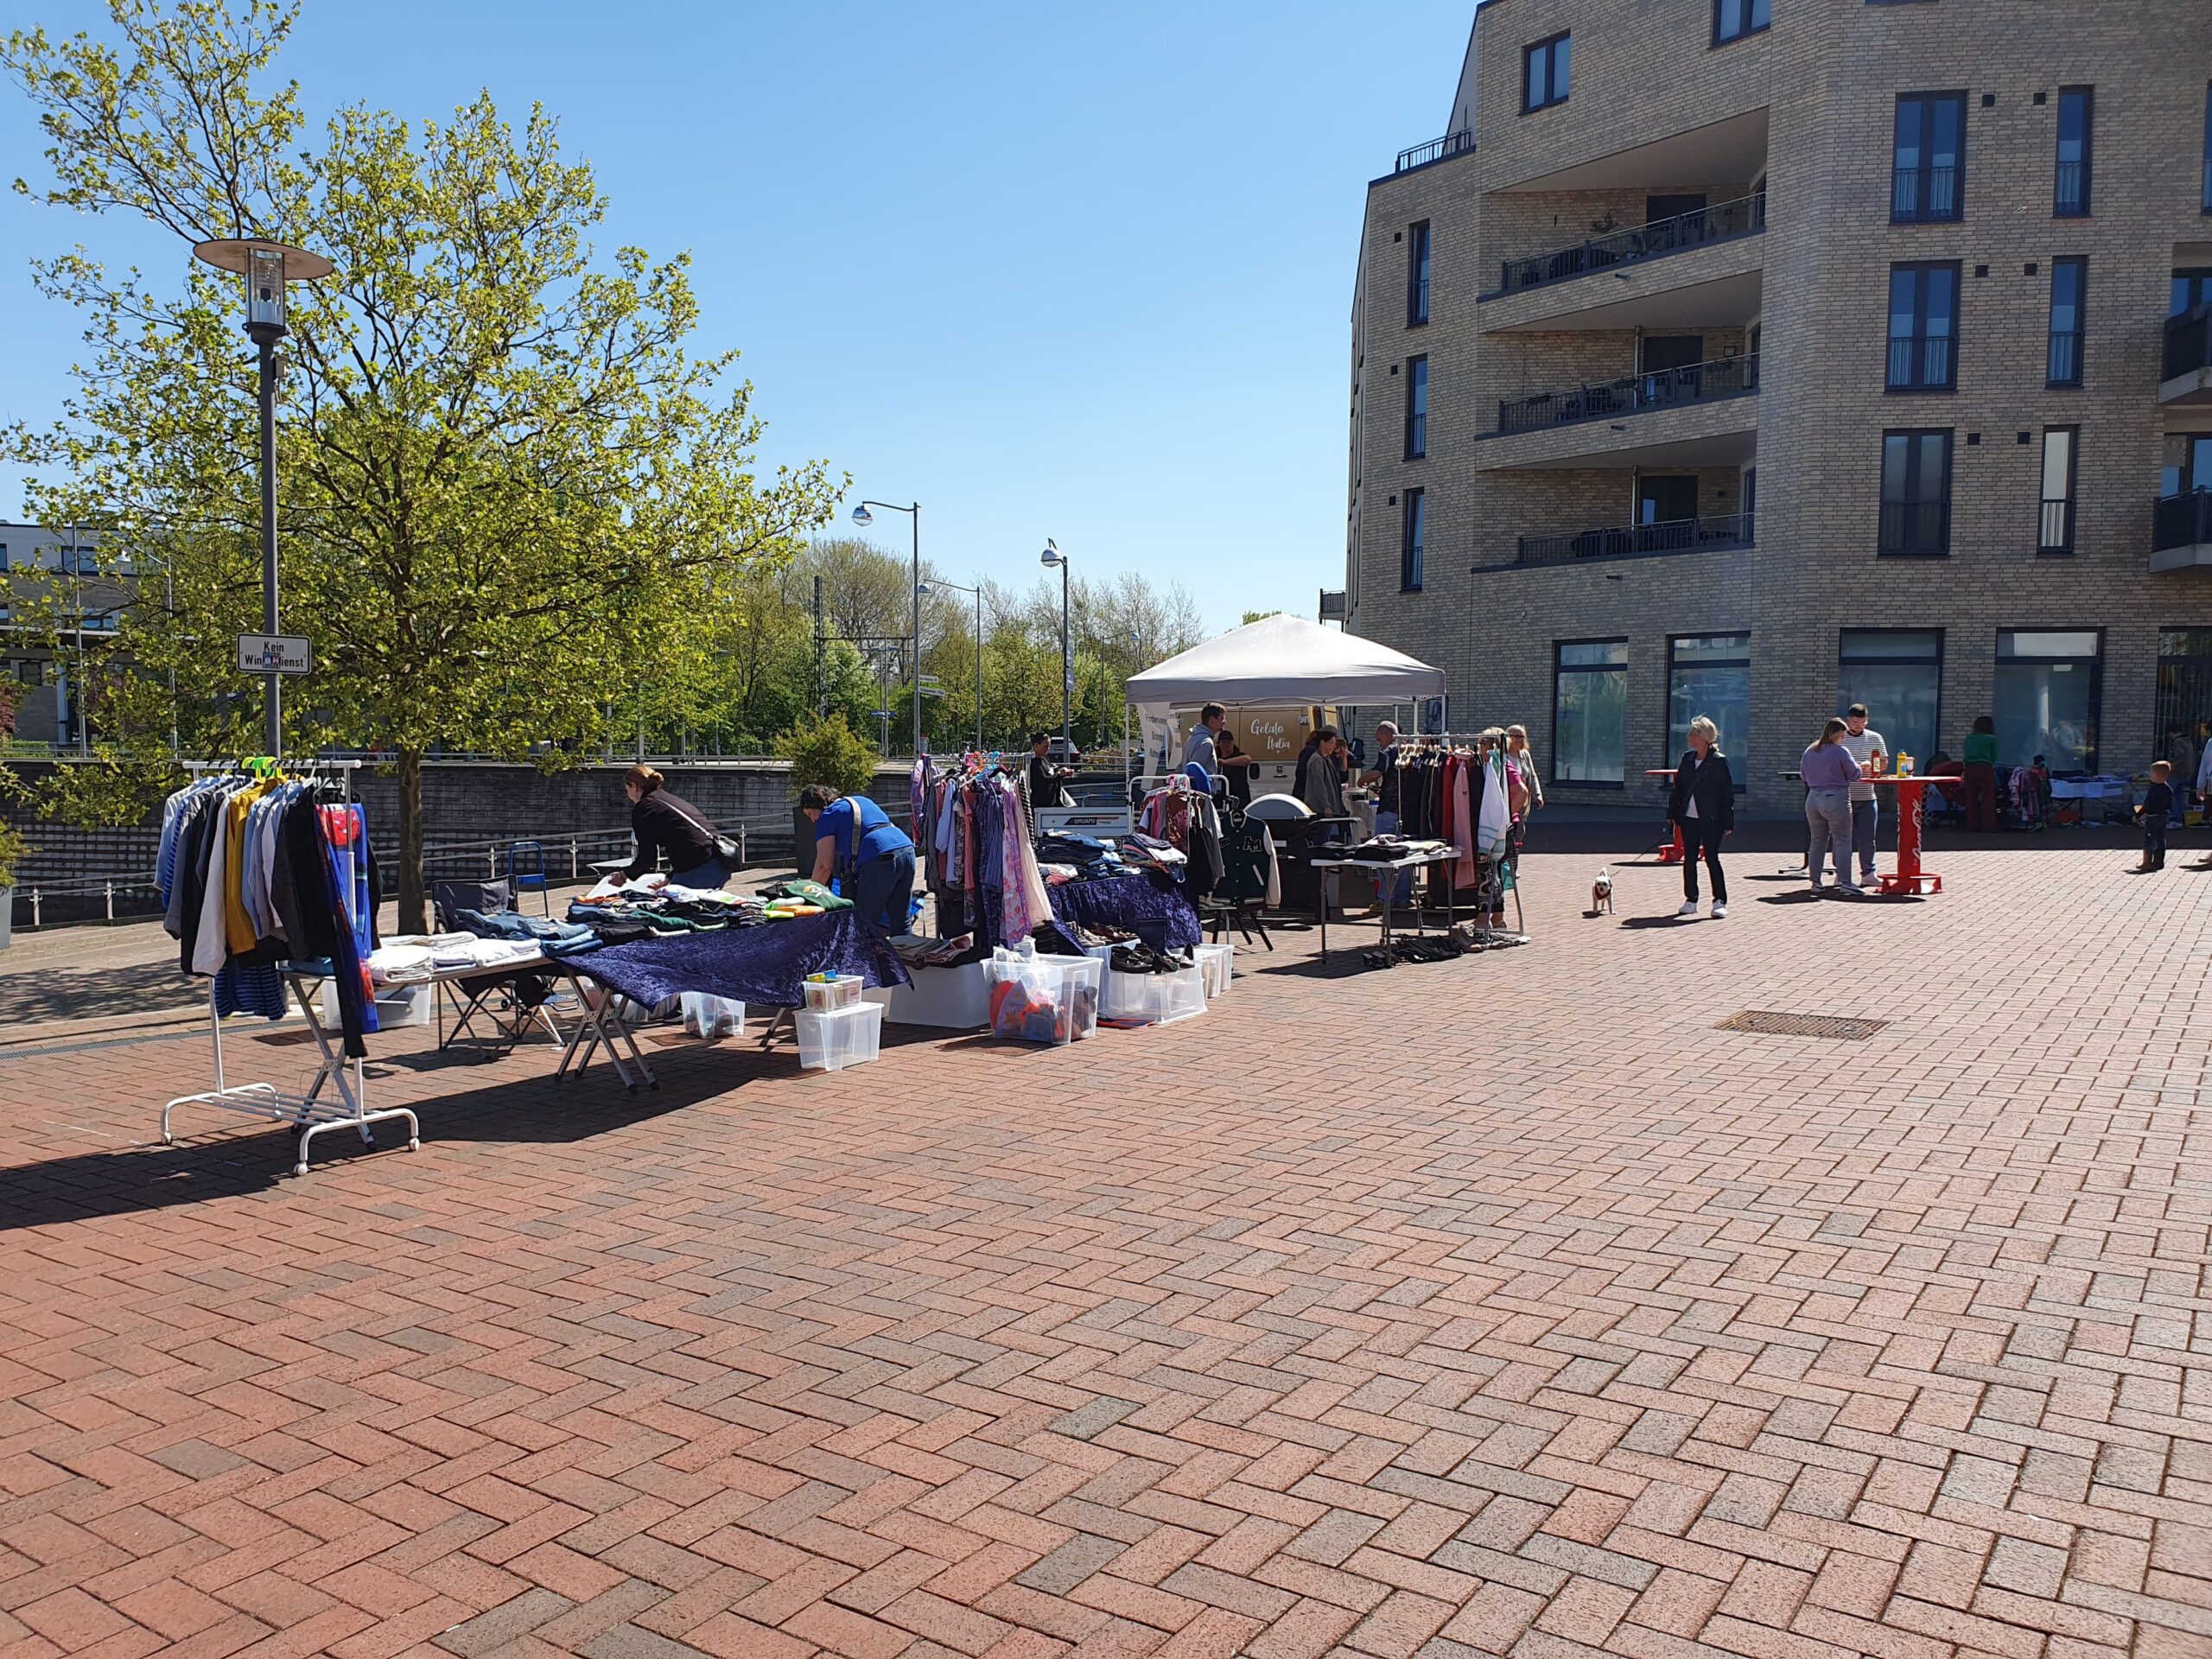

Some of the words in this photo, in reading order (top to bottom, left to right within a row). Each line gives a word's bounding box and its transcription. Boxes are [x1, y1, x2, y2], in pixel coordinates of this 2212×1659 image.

[264, 641, 284, 652] Kein
[1250, 719, 1284, 735] Gelato
[1267, 736, 1290, 750] Italia
